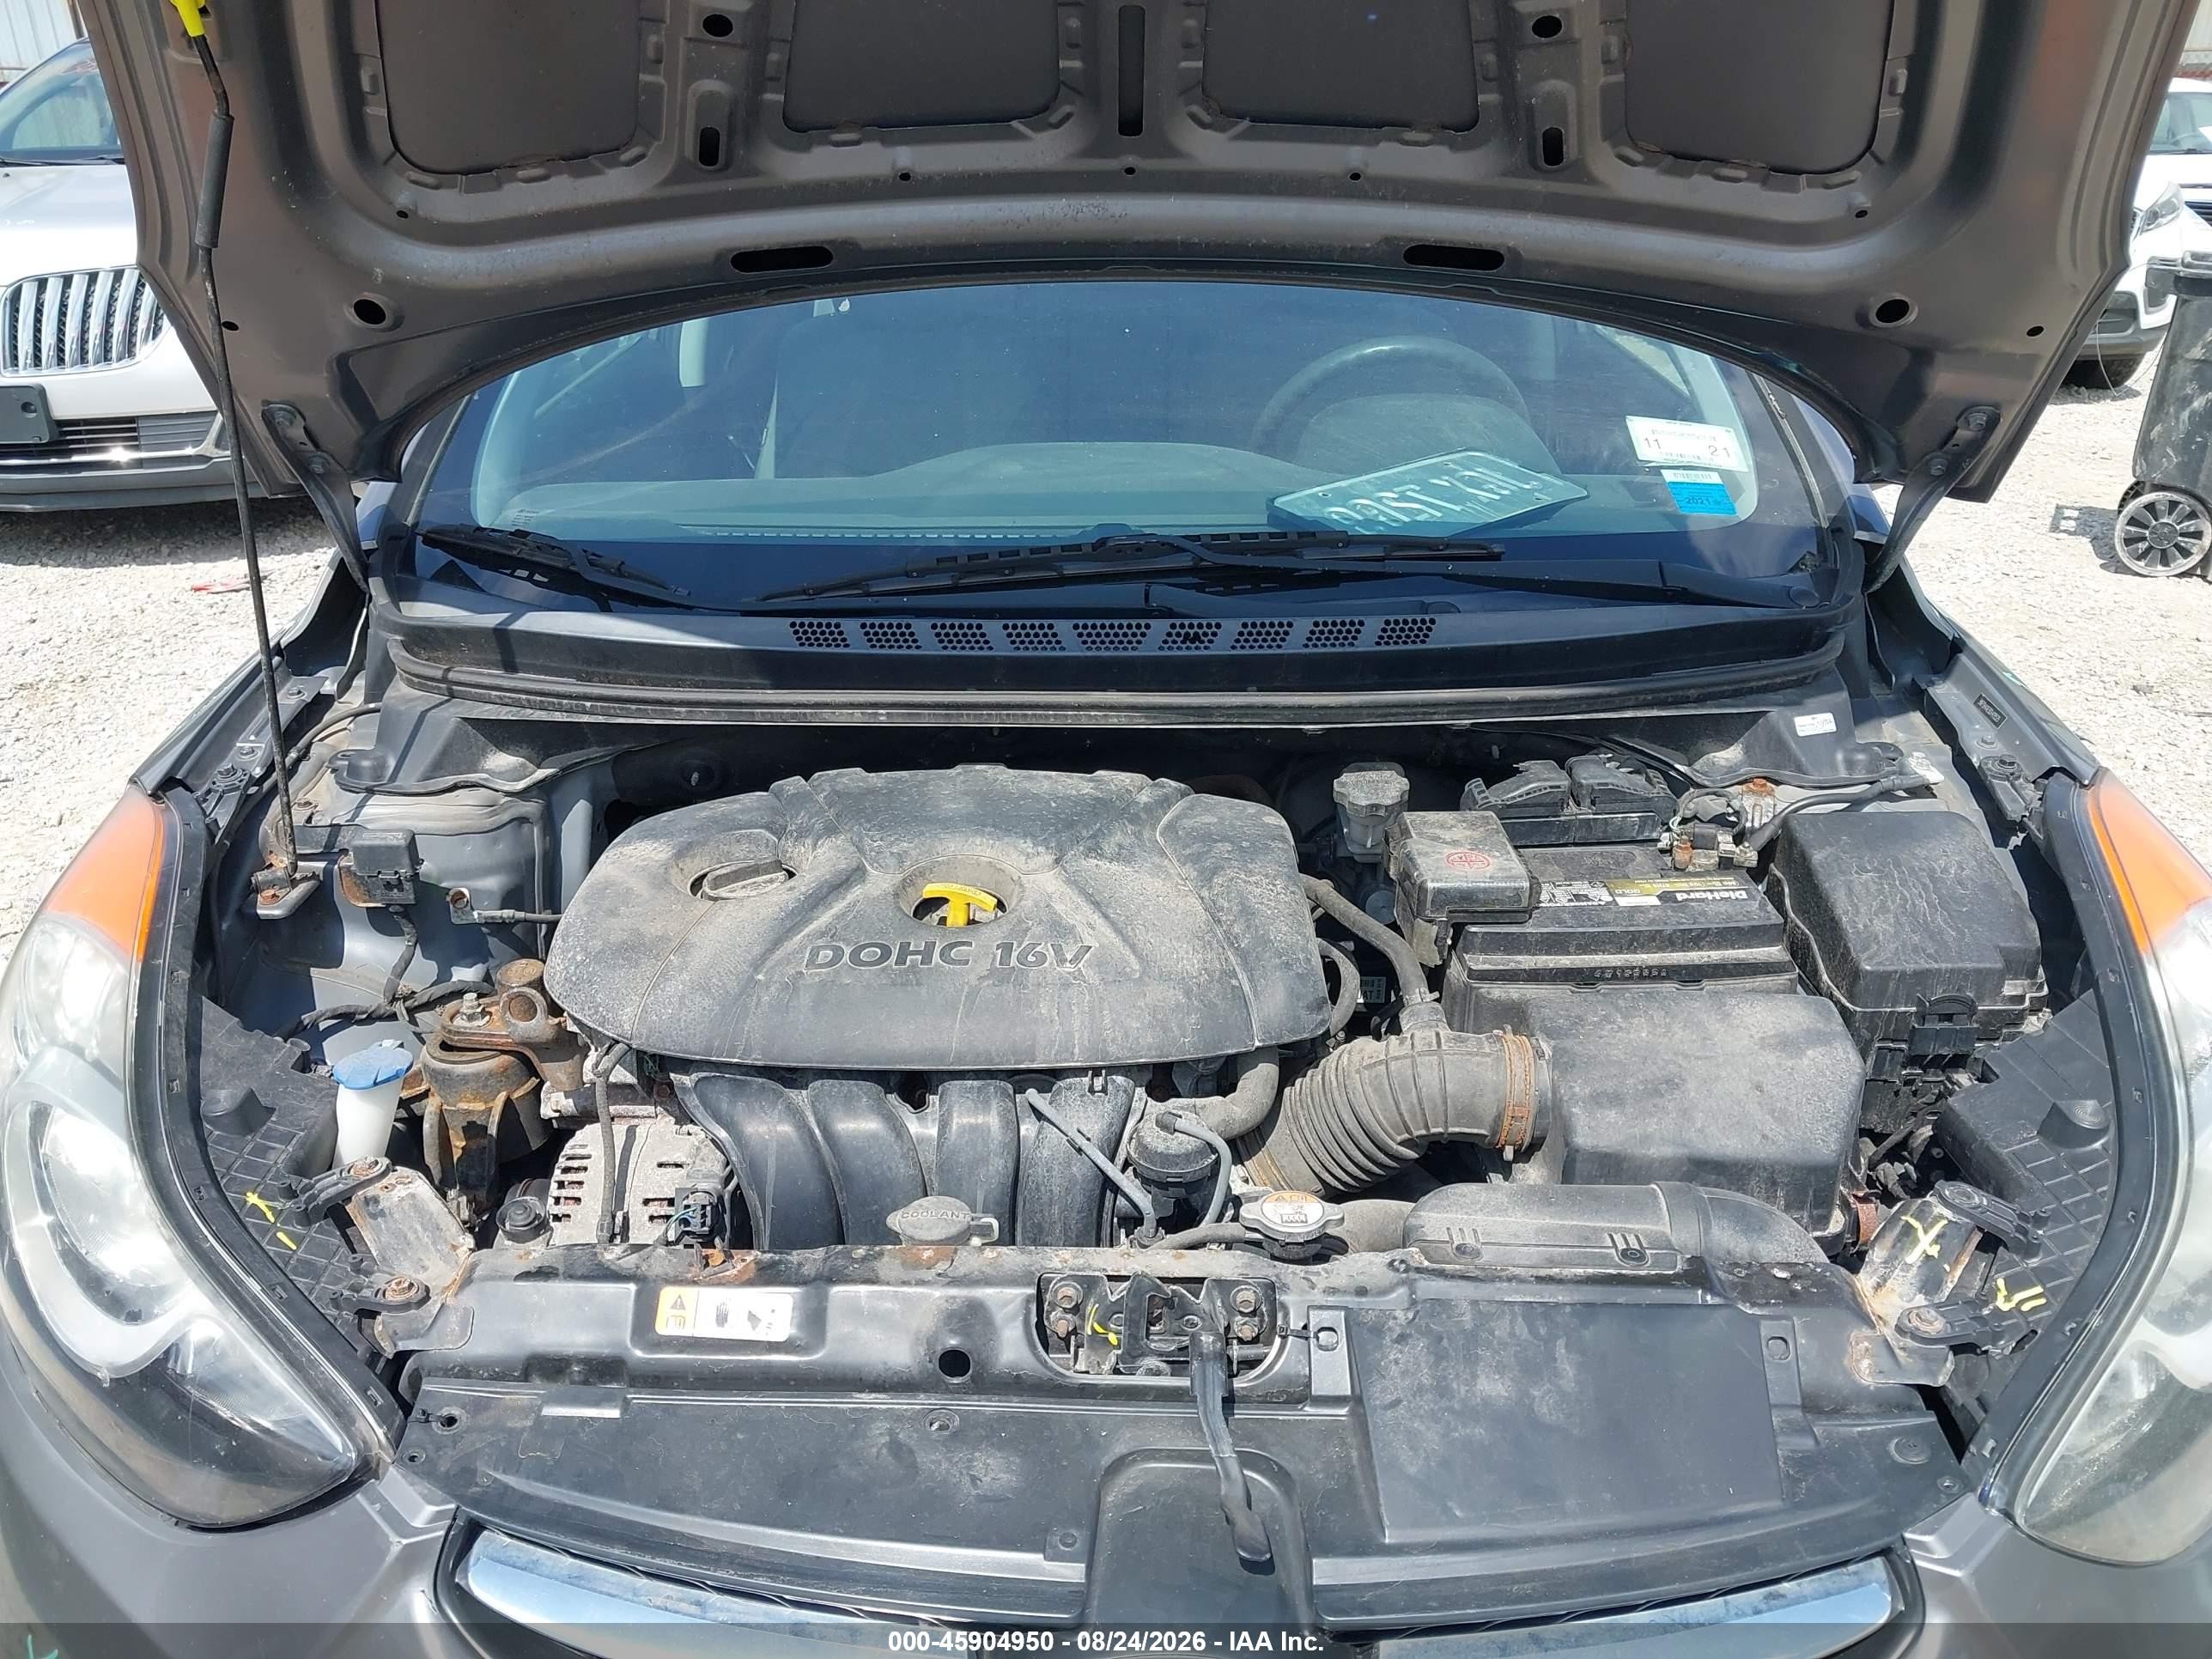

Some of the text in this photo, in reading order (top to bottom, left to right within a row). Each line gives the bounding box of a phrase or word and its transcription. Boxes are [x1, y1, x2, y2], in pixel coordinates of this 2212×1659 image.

[1675, 890, 1748, 902] DieHard
[803, 939, 1094, 972] DOHC 16V
[901, 1209, 971, 1221] COOLANT
